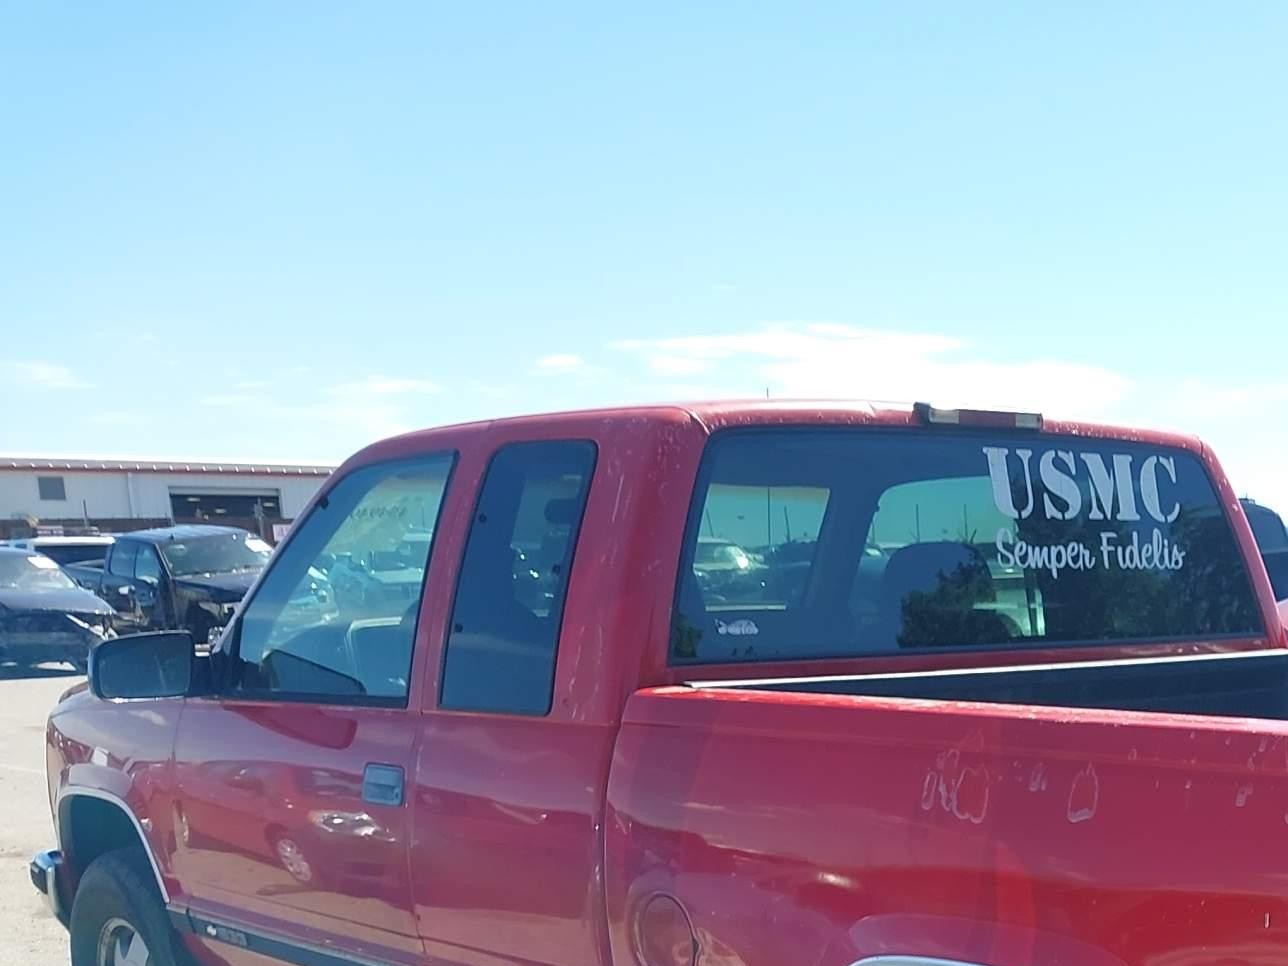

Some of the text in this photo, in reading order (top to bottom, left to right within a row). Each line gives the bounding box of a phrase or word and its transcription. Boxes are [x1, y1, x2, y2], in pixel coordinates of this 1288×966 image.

[982, 446, 1181, 524] USMC
[996, 527, 1186, 580] Semper Fidelis
